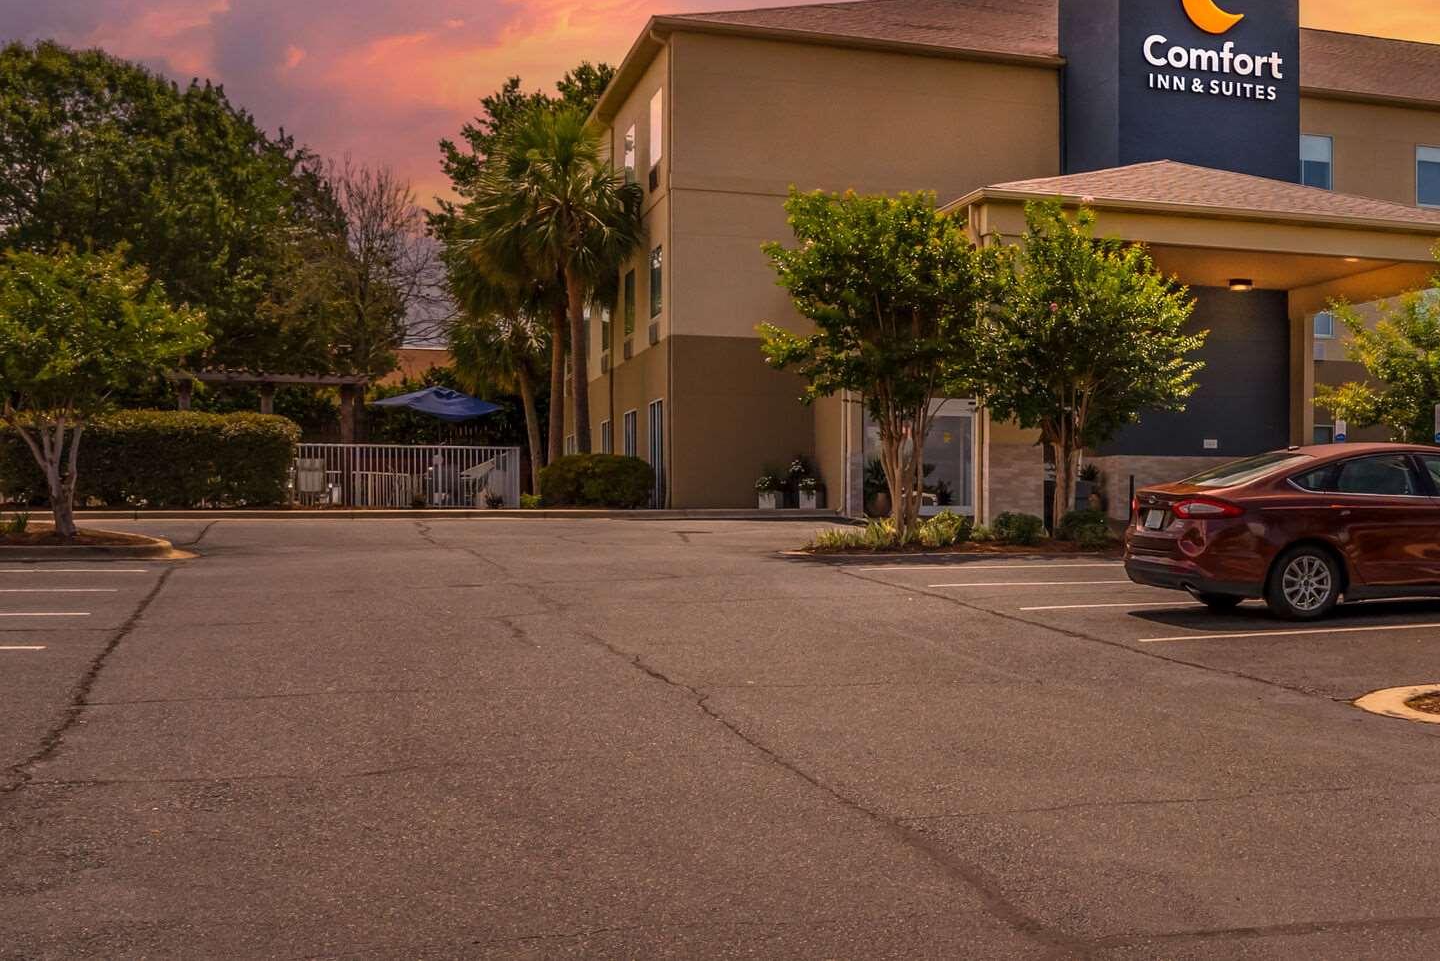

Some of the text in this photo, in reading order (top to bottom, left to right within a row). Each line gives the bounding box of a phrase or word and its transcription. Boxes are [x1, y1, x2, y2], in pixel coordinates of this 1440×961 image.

[1143, 34, 1283, 79] Comfort
[1149, 73, 1277, 101] INN & SUITES
